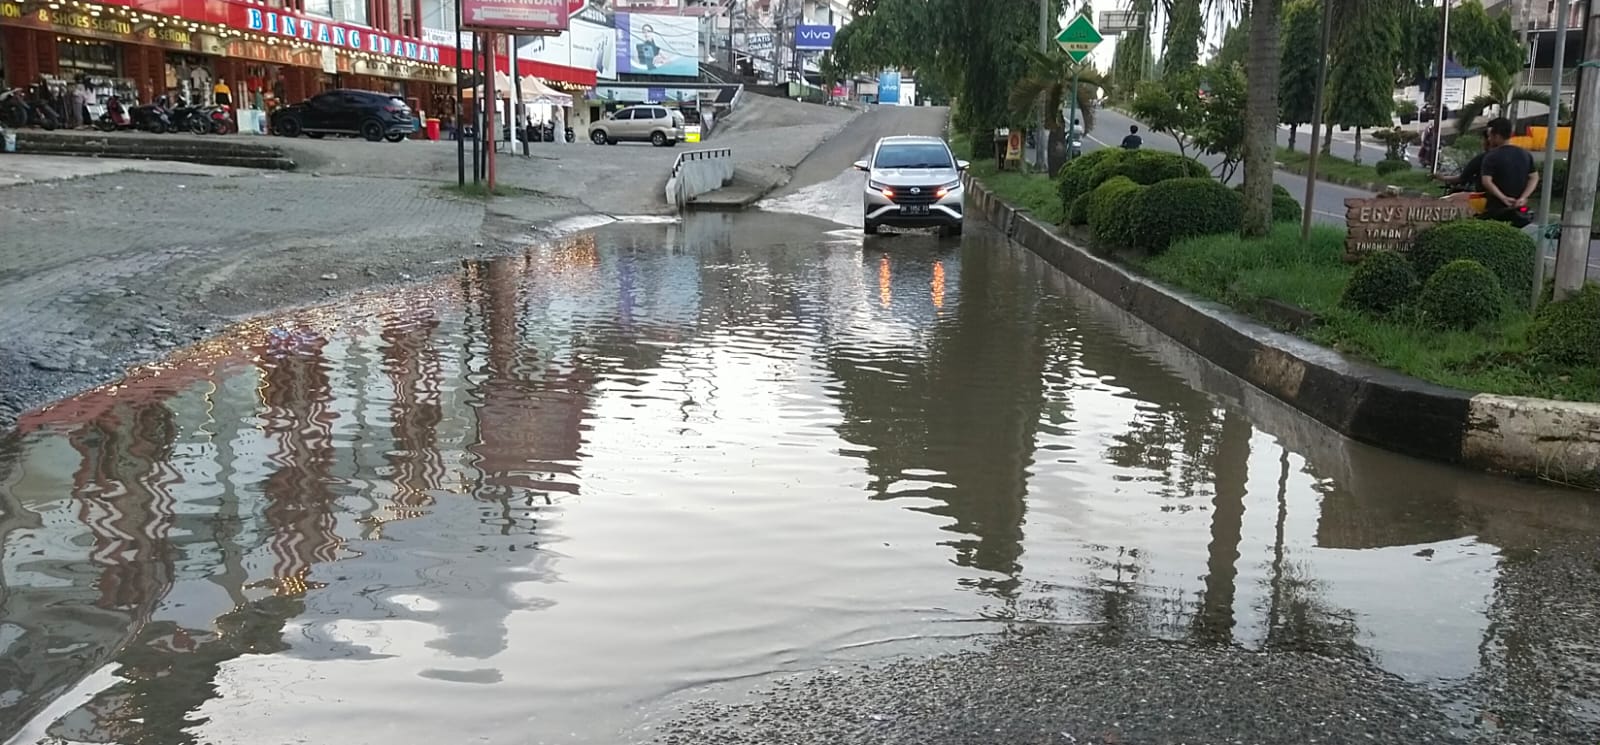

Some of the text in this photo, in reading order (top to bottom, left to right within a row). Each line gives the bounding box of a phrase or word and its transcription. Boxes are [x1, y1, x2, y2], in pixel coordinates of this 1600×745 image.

[38, 8, 49, 22] &
[52, 11, 90, 28] SHOES
[148, 27, 157, 39] &
[249, 8, 361, 49] BINTANG
[369, 34, 439, 64] IDAMAN
[801, 29, 831, 40] vivo
[1366, 228, 1401, 239] TAMAN
